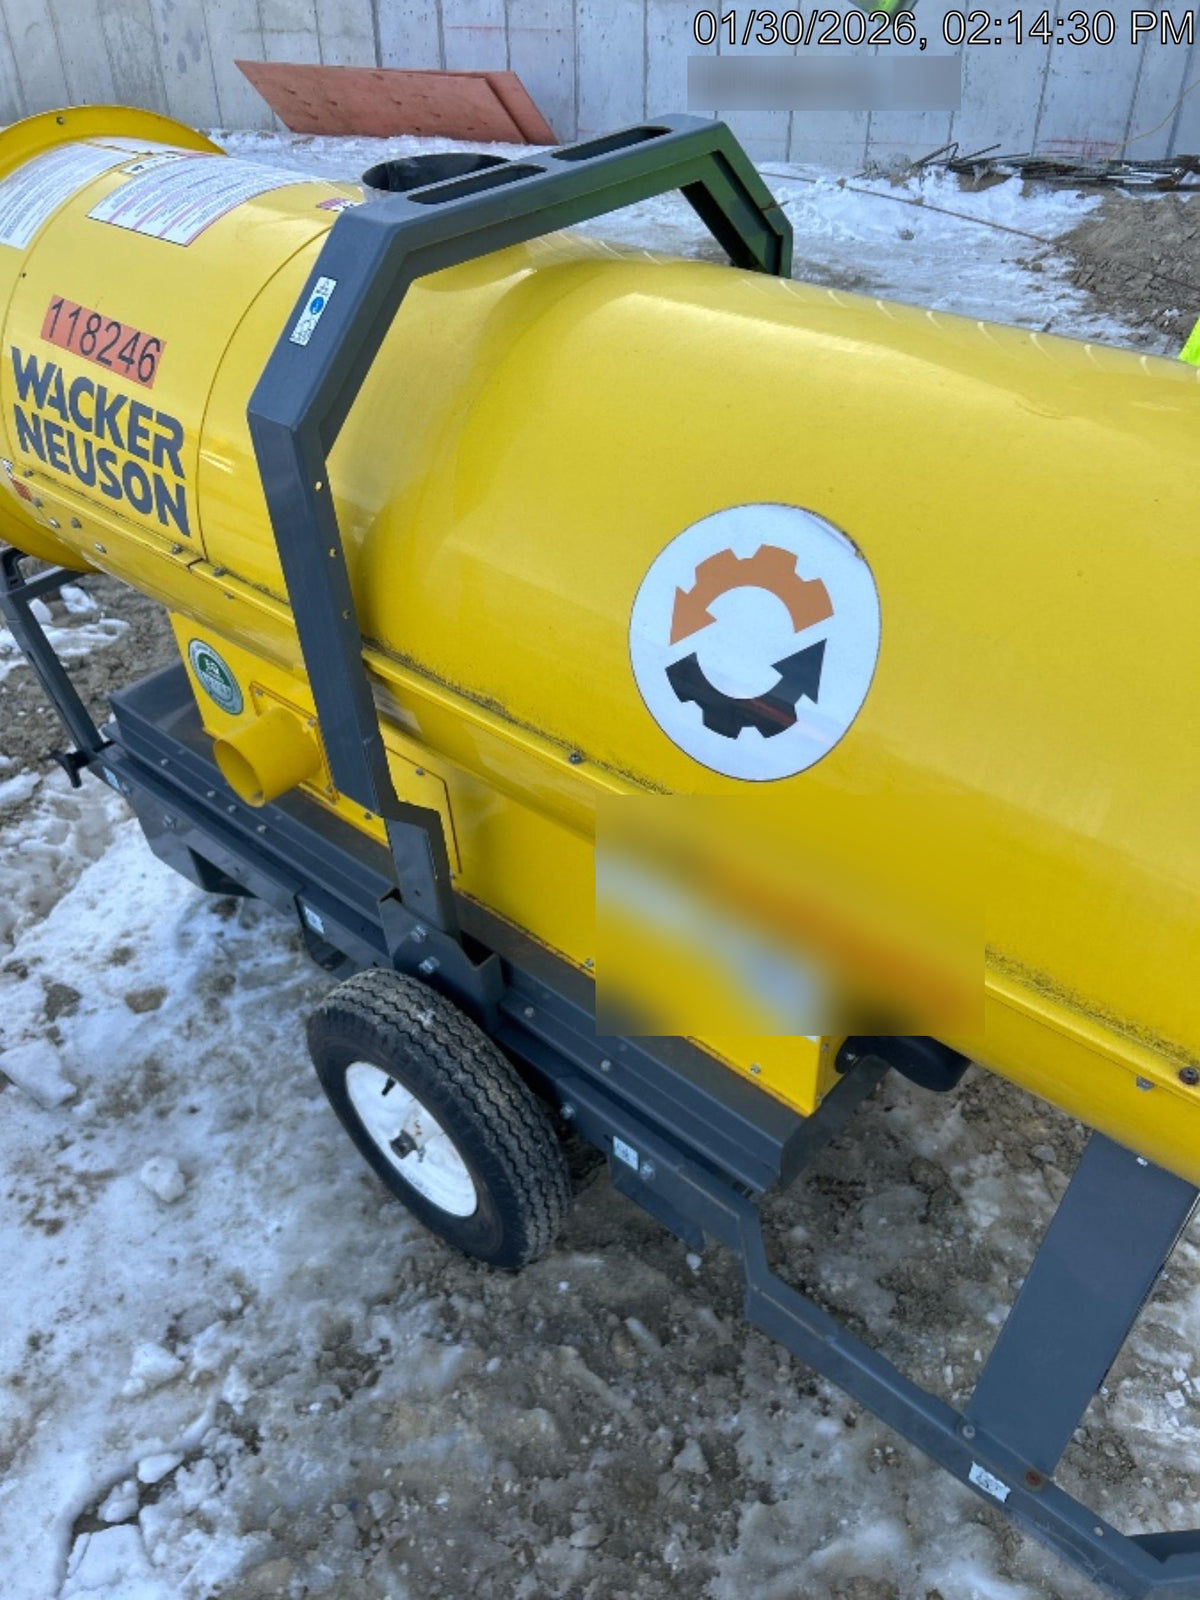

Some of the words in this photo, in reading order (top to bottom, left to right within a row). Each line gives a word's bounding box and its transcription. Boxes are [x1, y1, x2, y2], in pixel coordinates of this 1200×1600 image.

[48, 298, 161, 383] 118246
[10, 345, 187, 480] WACKER
[13, 403, 191, 538] NEUSON
